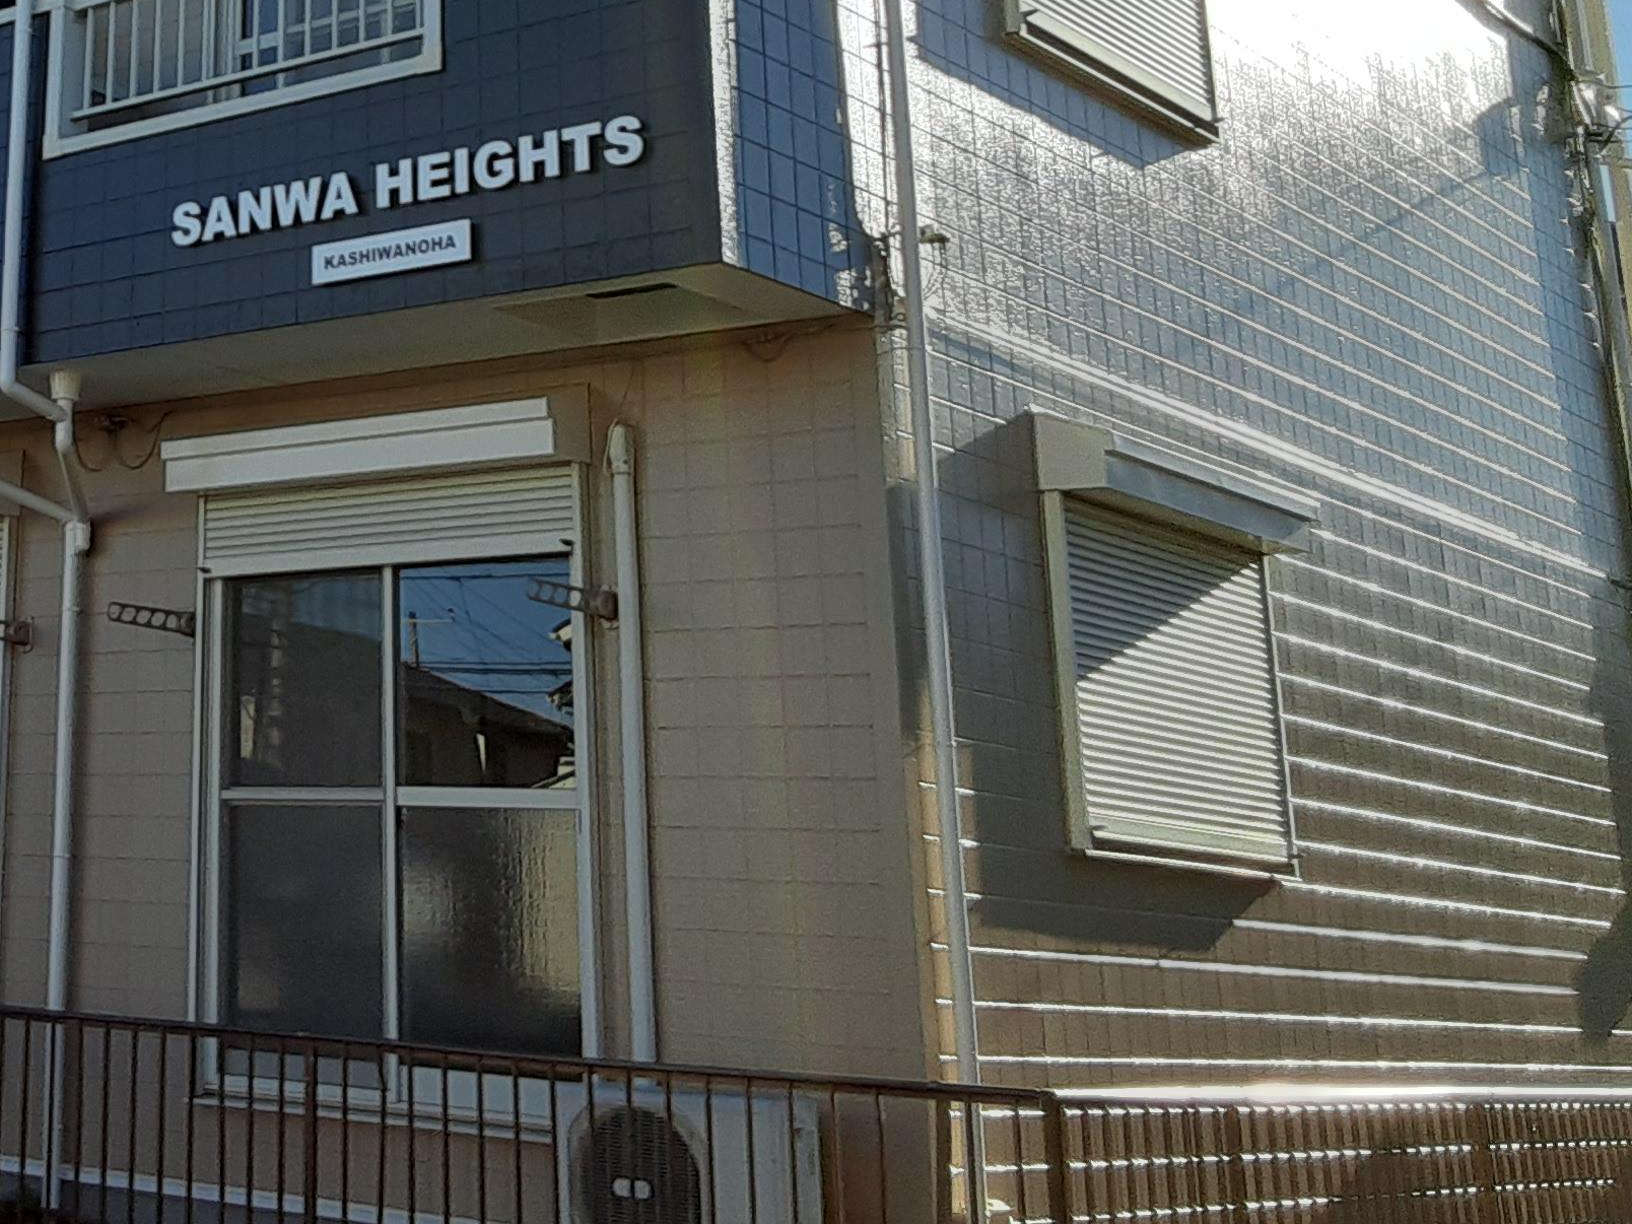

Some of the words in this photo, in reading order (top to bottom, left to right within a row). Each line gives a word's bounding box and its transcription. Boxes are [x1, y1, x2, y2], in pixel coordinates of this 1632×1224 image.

[171, 173, 358, 246] SANWA
[376, 115, 645, 208] HEIGHTS
[323, 234, 457, 270] KASHIWANOHA
